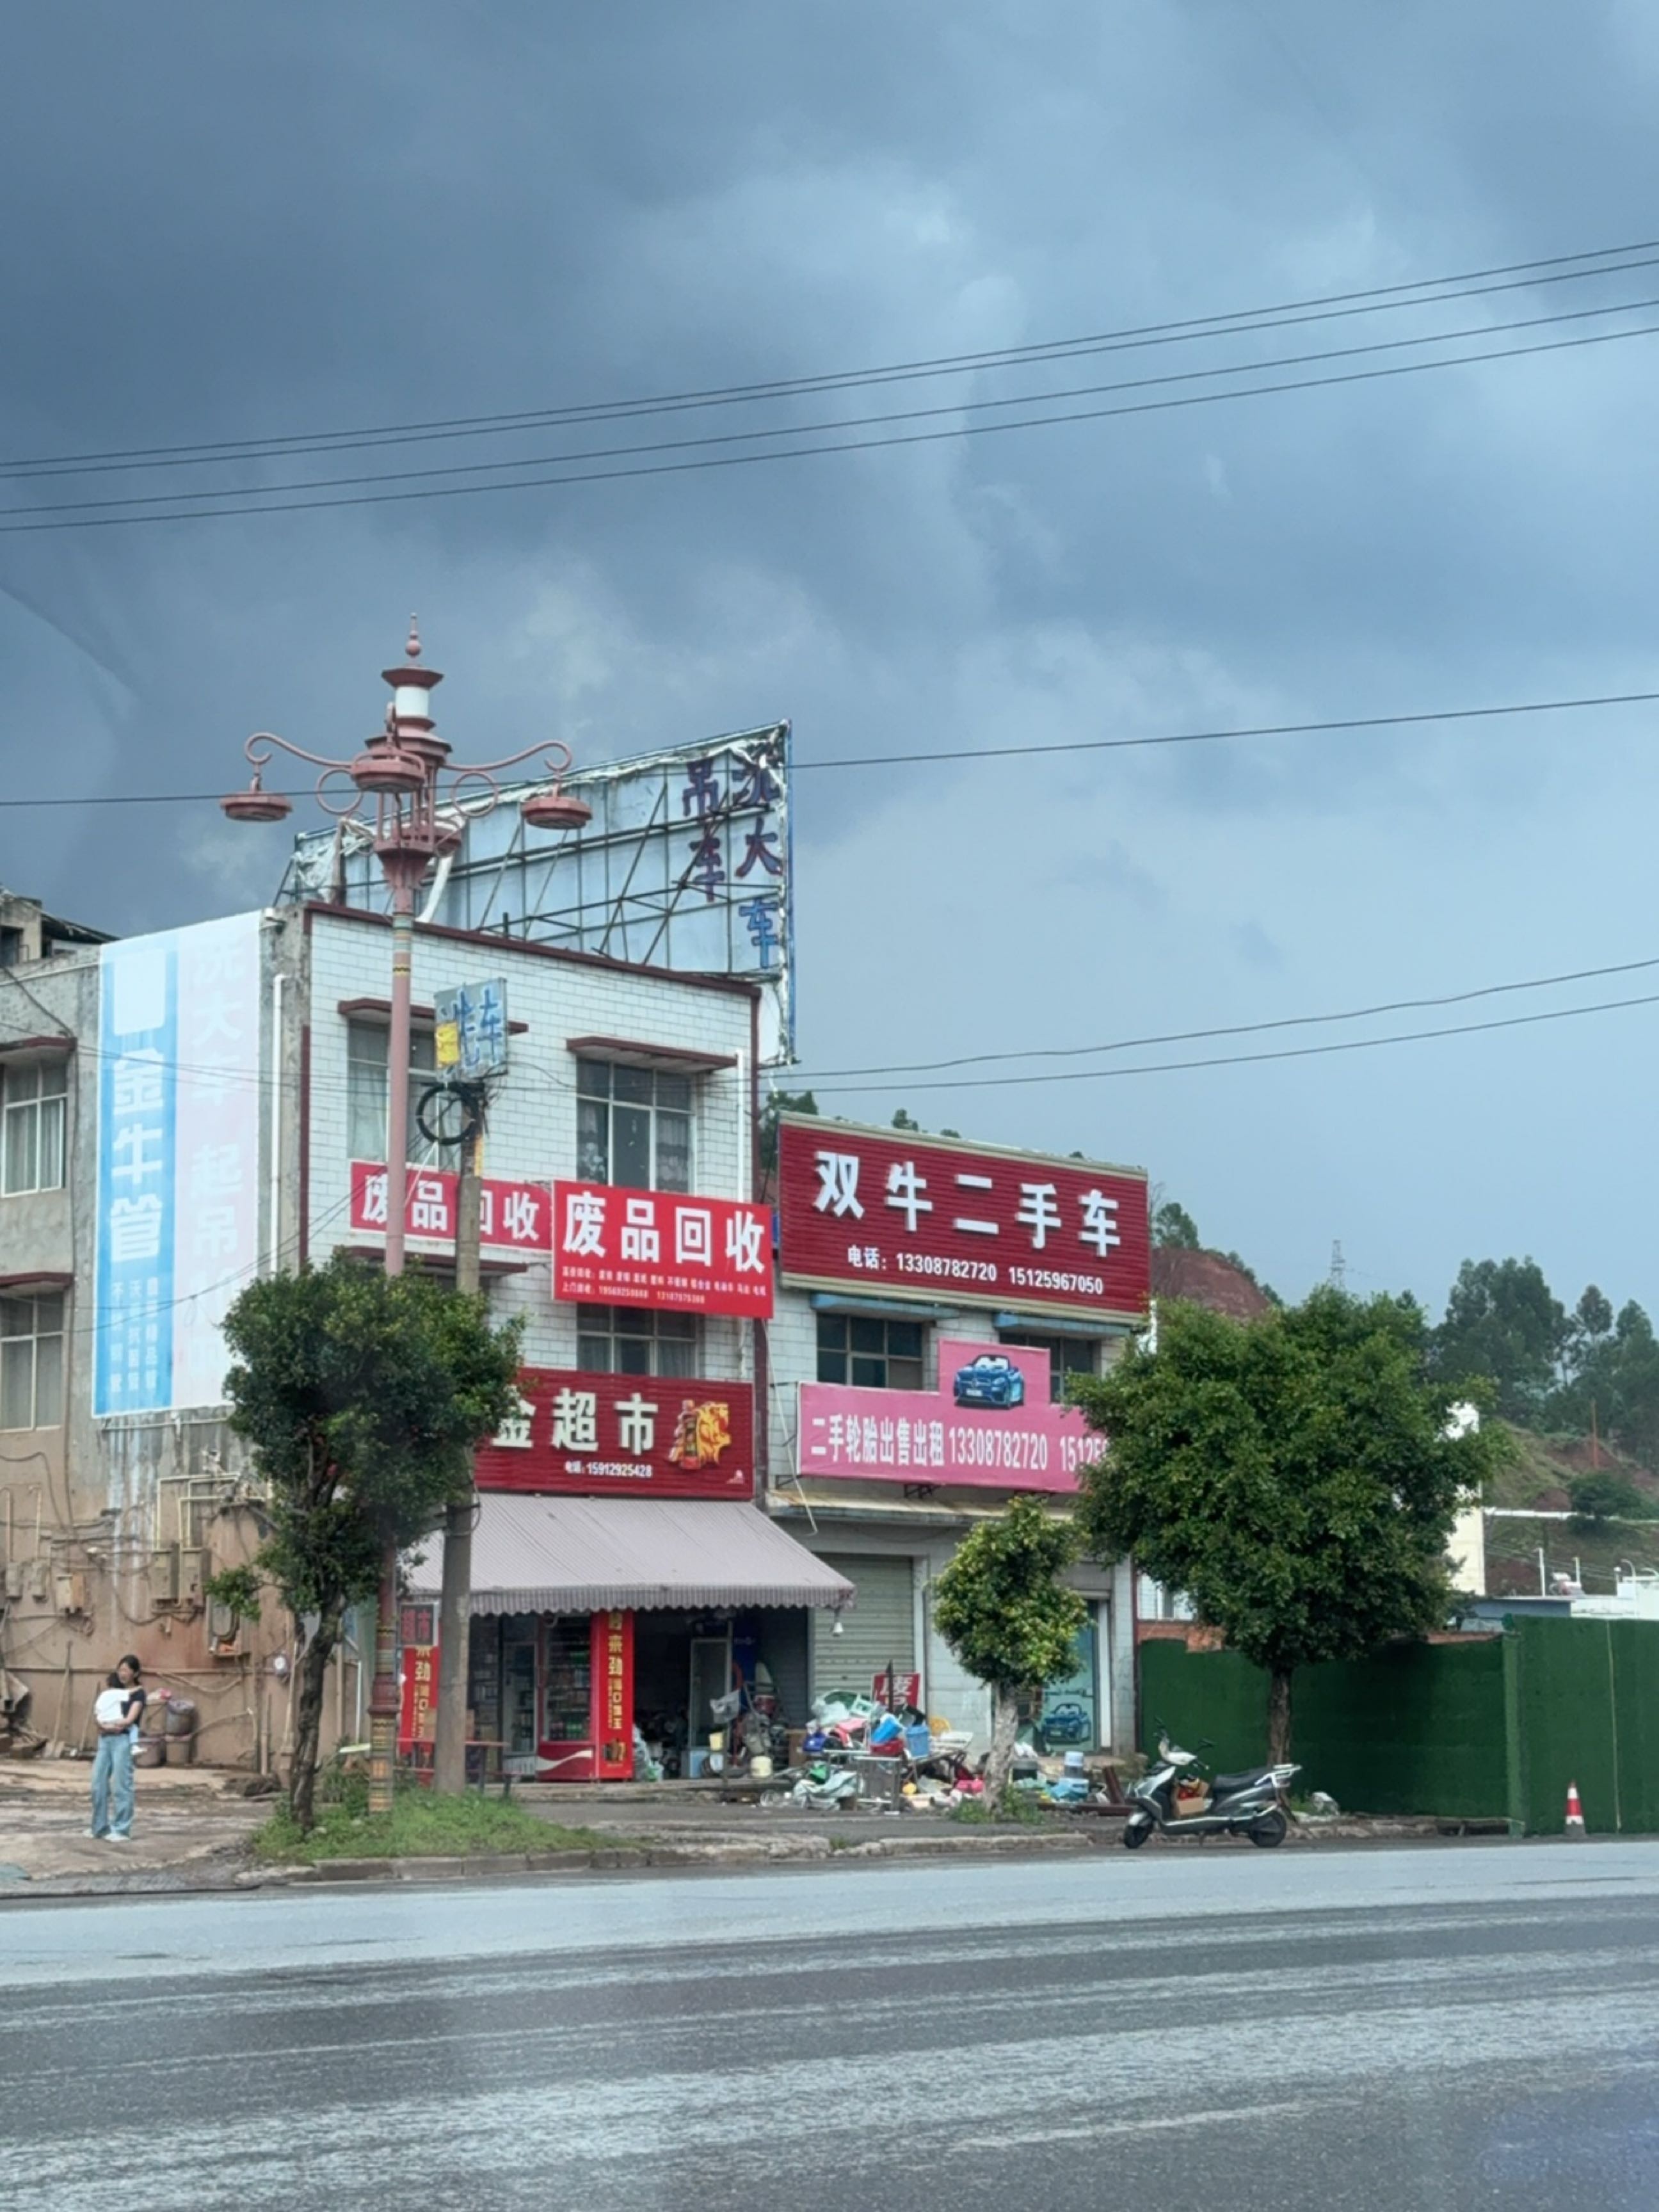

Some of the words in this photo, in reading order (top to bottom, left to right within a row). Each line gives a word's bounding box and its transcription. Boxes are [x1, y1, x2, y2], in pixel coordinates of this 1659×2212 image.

[562, 1190, 765, 1274] 废品回收
[812, 1150, 1121, 1257] 双牛二手车
[897, 1253, 997, 1282] 13308782720
[1009, 1267, 1104, 1296] 15125967050
[949, 1428, 1048, 1471] 13308782720
